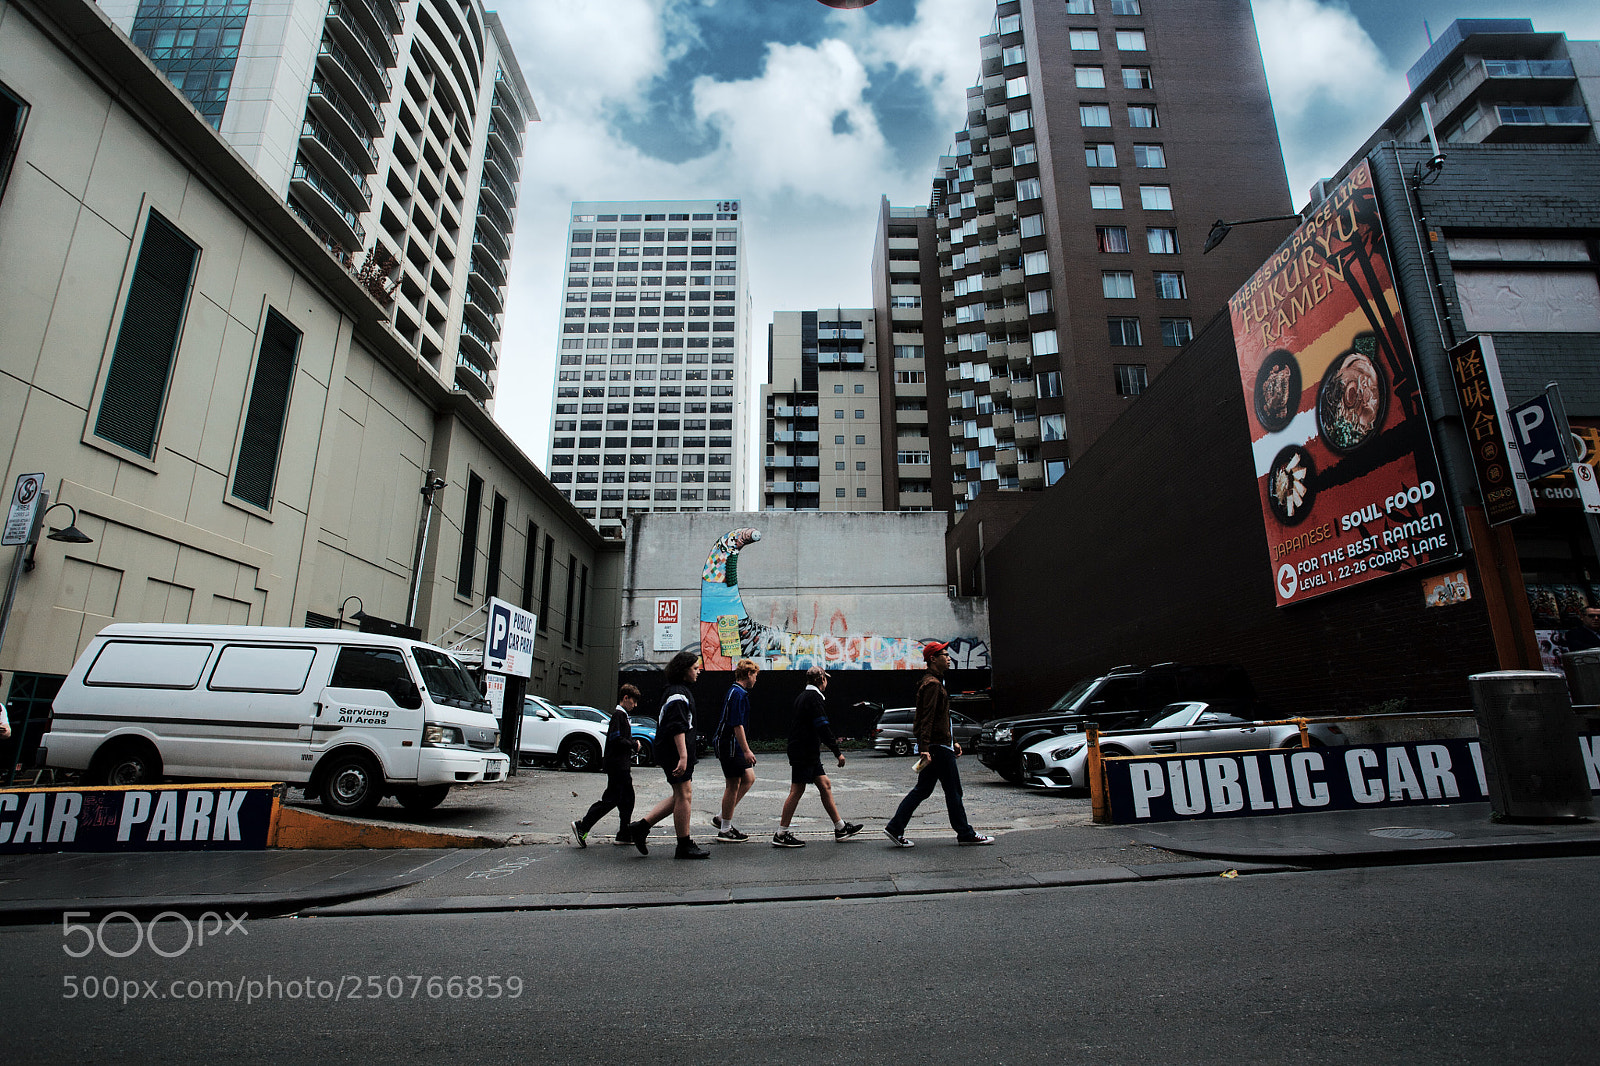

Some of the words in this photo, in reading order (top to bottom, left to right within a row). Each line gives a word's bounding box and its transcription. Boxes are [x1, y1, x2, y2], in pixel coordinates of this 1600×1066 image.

[716, 201, 738, 212] 150
[1232, 266, 1272, 312] THERE'S
[1292, 204, 1333, 253] PLACE
[1334, 167, 1368, 210] LIKE
[1243, 203, 1359, 334] FUKURYU
[1260, 255, 1346, 349] RAMEN
[1515, 404, 1545, 446] P
[1272, 522, 1333, 562] JAPANESE
[1341, 502, 1383, 531] SOUL
[1385, 480, 1436, 515] FOOD
[1297, 557, 1320, 576] FOR
[1321, 549, 1345, 567] THE
[1347, 534, 1379, 559] BEST
[1382, 512, 1444, 546] RAMEN
[1299, 575, 1327, 592] LEVEL
[1328, 570, 1337, 583] 1,
[1338, 559, 1368, 579] 22-26
[1368, 545, 1410, 570] CORRS
[1411, 533, 1448, 556] LANE
[493, 613, 506, 650] P
[513, 612, 532, 634] PUBLIC
[660, 602, 677, 616] FAD
[508, 632, 520, 652] CAR
[519, 635, 534, 655] PARK
[337, 715, 353, 723] All
[355, 716, 388, 725] Areas
[338, 707, 390, 718] Servicing
[1129, 751, 1330, 819] PUBLIC
[1345, 743, 1461, 804] CAR
[0, 792, 83, 844] CAR
[116, 790, 249, 842] PARK
